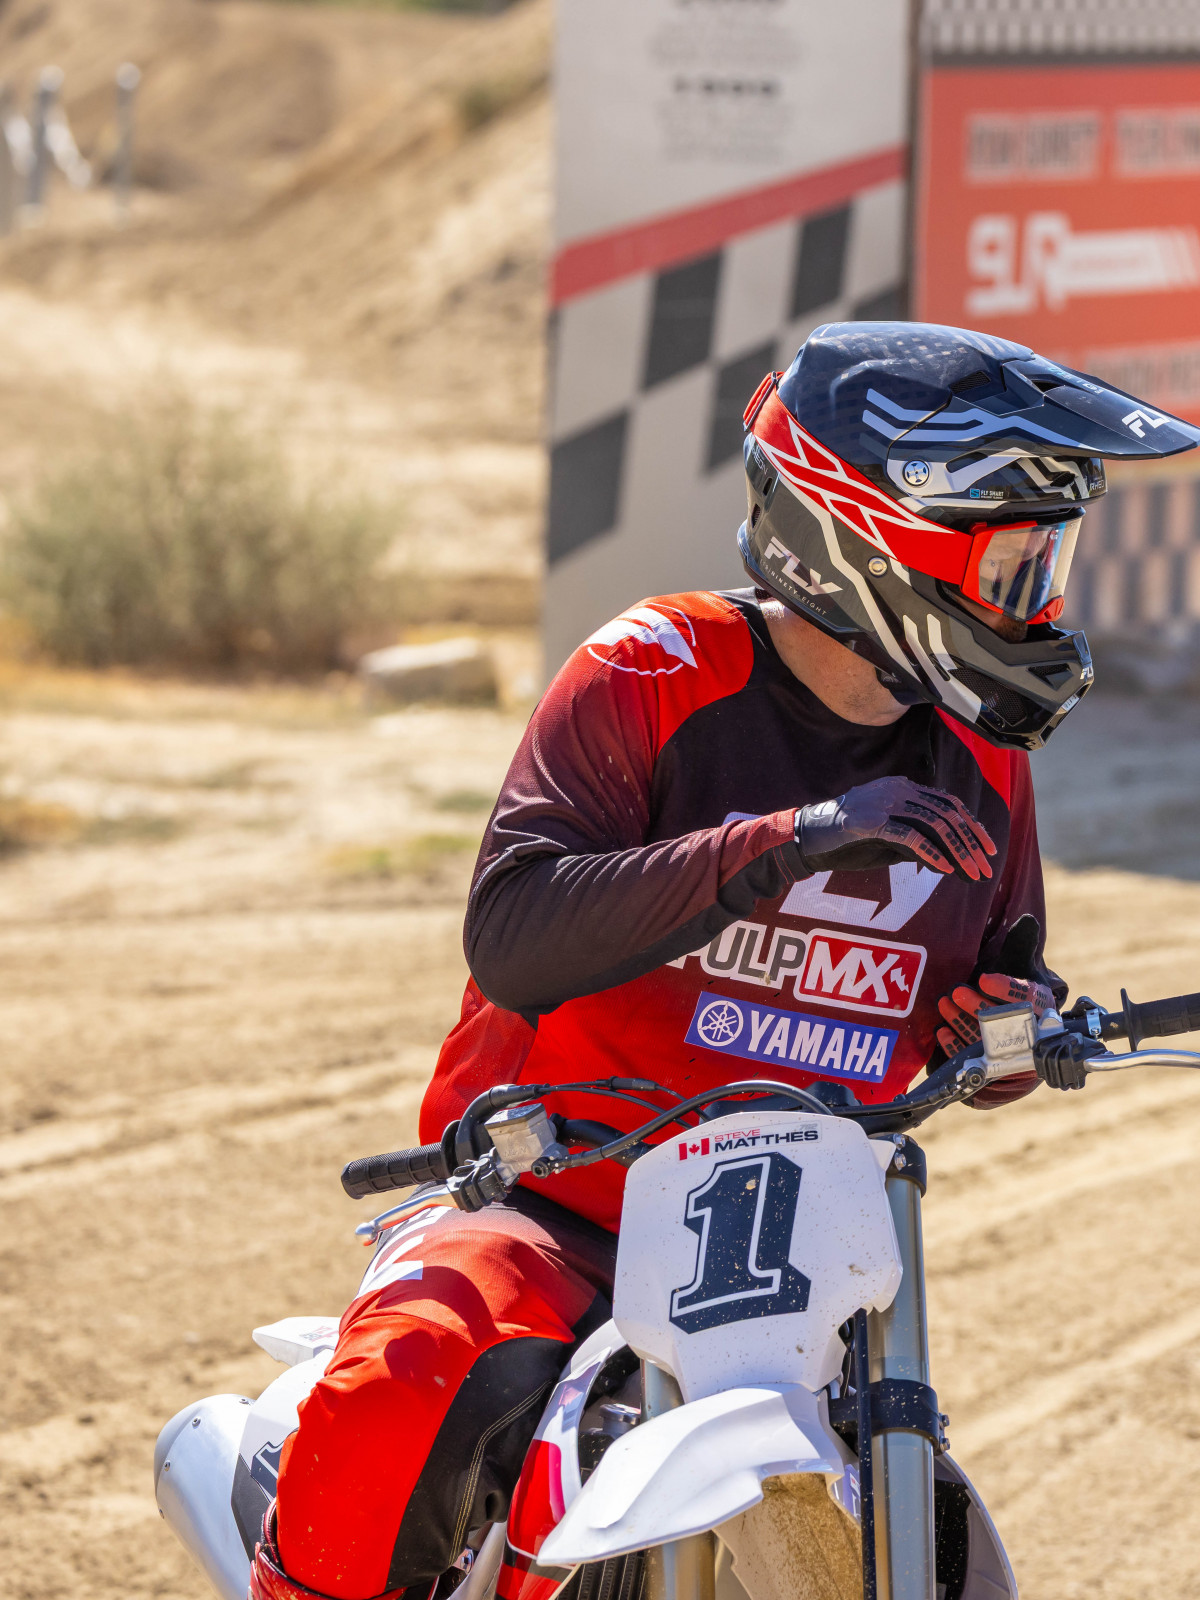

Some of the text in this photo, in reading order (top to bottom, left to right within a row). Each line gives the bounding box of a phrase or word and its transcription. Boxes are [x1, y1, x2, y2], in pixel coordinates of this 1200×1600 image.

[764, 536, 843, 596] FLY
[748, 1009, 890, 1077] YAMAHA
[715, 1128, 760, 1143] STEVE
[715, 1130, 819, 1153] MATTHES
[669, 1152, 812, 1335] 1
